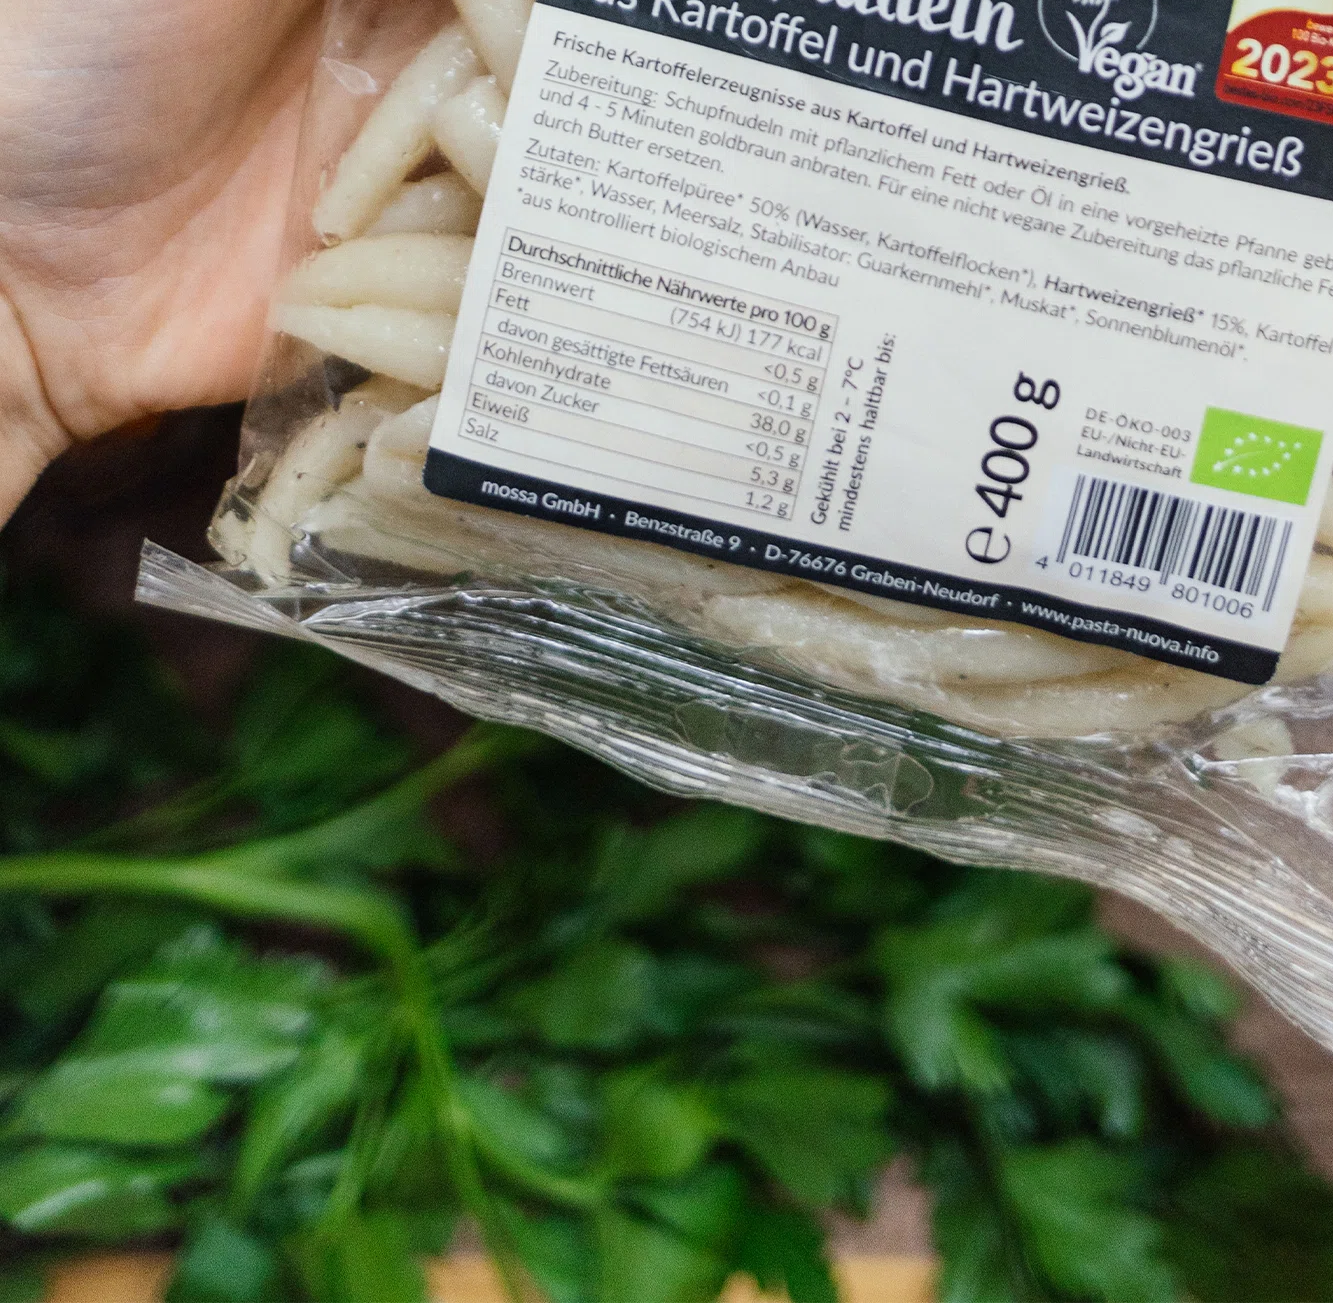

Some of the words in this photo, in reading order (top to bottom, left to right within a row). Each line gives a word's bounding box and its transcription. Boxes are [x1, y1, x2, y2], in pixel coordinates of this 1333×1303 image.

[533, 110, 582, 135] durch
[587, 122, 643, 149] Butter
[553, 30, 616, 60] Frische
[621, 48, 805, 111] Kartoffelerzeugnisse
[810, 103, 840, 120] aus
[846, 109, 927, 143] Kartoffel
[931, 136, 967, 154] und
[847, 42, 932, 88] und
[942, 57, 1304, 176] Hartweizengrieß
[525, 137, 595, 169] Zutaten:
[749, 196, 788, 221] 50%
[539, 88, 574, 106] und
[577, 95, 588, 110] 4
[605, 101, 617, 117] 5
[621, 105, 694, 138] Minuten
[697, 130, 786, 163] goldbraun
[877, 174, 908, 195] Für
[910, 186, 948, 207] eine
[952, 196, 998, 220] nicht
[1002, 210, 1066, 236] vegane
[1069, 222, 1179, 266] Zubereitung
[1183, 251, 1214, 270] das
[1217, 259, 1312, 291] pflanzliche
[544, 59, 658, 108] Zubereitung:
[664, 90, 783, 136] Schupfnudeln
[789, 128, 818, 146] mit
[823, 136, 934, 178] pflanzlichem
[941, 165, 977, 188] Fett
[983, 180, 1025, 200] oder
[1030, 185, 1052, 206] Öl
[1057, 193, 1073, 212] in
[1080, 202, 1119, 222] eine
[1125, 214, 1229, 247] vorgeheizte
[1235, 234, 1297, 262] Pfanne
[508, 235, 652, 287] Durchschnittliche
[656, 276, 746, 313] Nährwerte
[749, 305, 779, 321] pro
[784, 310, 816, 331] 100
[818, 323, 830, 338] g
[557, 197, 655, 237] kontrolliert
[659, 224, 776, 270] biologischem
[780, 258, 839, 287] Anbau
[750, 222, 851, 261] Stabilisator:
[495, 287, 530, 311] Fett
[806, 375, 818, 391] g
[501, 261, 594, 300] Brennwert
[716, 319, 741, 342] kJ)
[747, 328, 783, 349] 177
[786, 338, 822, 361] kcal
[482, 340, 610, 389] Kohlenhydrate
[793, 428, 805, 443] g
[497, 318, 548, 344] davon
[550, 336, 635, 367] gesättigte
[639, 355, 728, 392] Fettsäuren
[799, 402, 811, 417] g
[834, 411, 850, 423] 2
[465, 417, 498, 442] Salz
[776, 502, 788, 516] g
[471, 391, 529, 422] Eiweiß
[782, 478, 794, 494] g
[485, 370, 536, 396] davon
[540, 384, 599, 412] Zucker
[787, 453, 800, 470] g
[826, 427, 846, 455] bei
[837, 436, 871, 531] mindestens
[858, 367, 886, 429] haltbar
[874, 332, 897, 363] bis:
[975, 415, 1038, 518] 400
[1013, 371, 1060, 410] g
[1076, 444, 1182, 478] Landwirtschaft
[1085, 407, 1191, 442] DE-ÖKO-003
[810, 459, 839, 525] Gekühlt
[481, 480, 537, 504] mossa
[541, 492, 600, 518] GmbH
[624, 510, 724, 547] Benzstraße
[728, 535, 741, 550] 9
[764, 544, 846, 575] D-76676
[850, 564, 999, 607] Graben-Neudorf
[1035, 555, 1047, 569] 4
[1068, 561, 1150, 591] 011849
[1171, 583, 1254, 618] 801006
